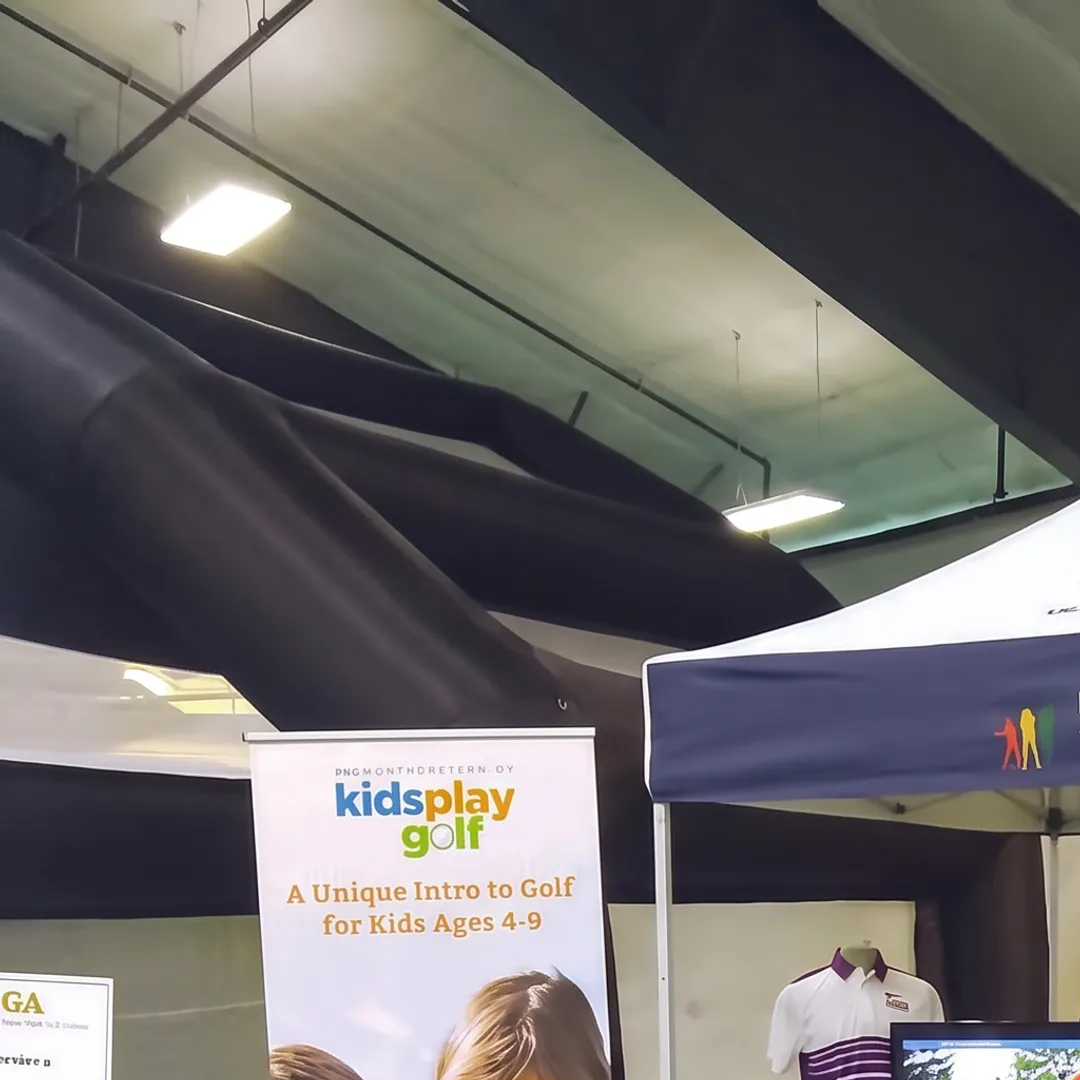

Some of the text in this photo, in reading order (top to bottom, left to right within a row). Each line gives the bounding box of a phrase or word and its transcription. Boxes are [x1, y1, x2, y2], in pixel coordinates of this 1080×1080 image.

[335, 780, 515, 822] kidsplay
[401, 815, 484, 859] golf
[286, 876, 576, 908] A Unique Intro to Golf
[322, 911, 542, 938] for Kids Ages 4-9
